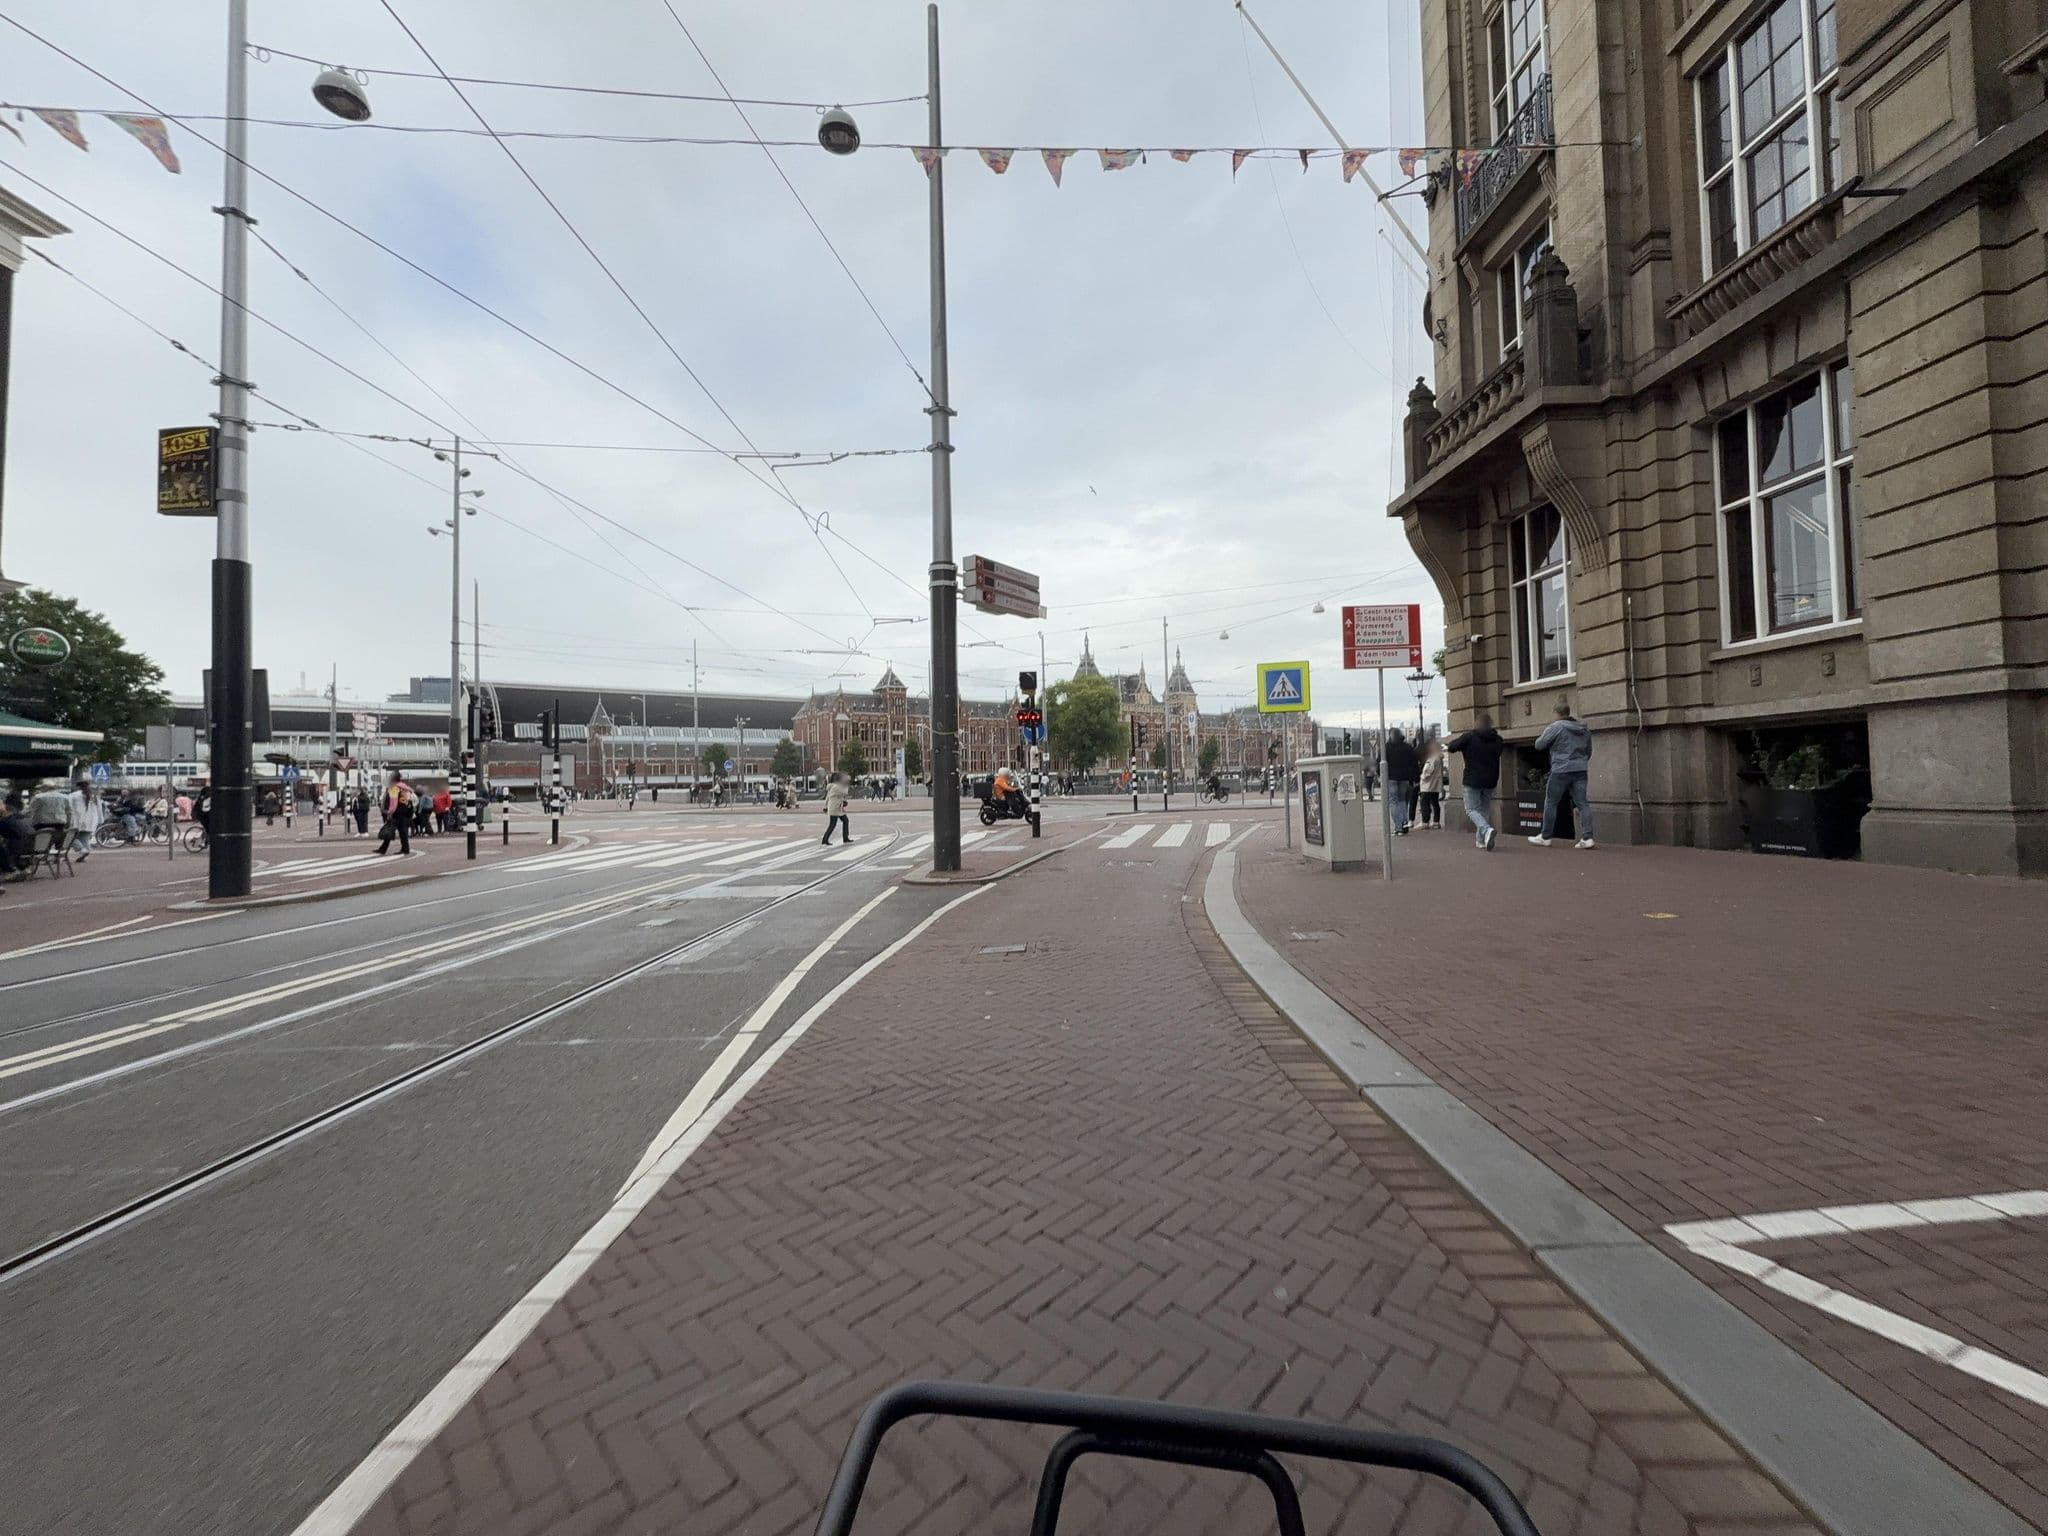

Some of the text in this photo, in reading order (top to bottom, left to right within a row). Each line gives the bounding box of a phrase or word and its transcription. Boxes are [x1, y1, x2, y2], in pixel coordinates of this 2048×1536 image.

[161, 432, 209, 457] LOST
[1364, 615, 1391, 623] Stalling
[1356, 622, 1394, 630] Purmerend
